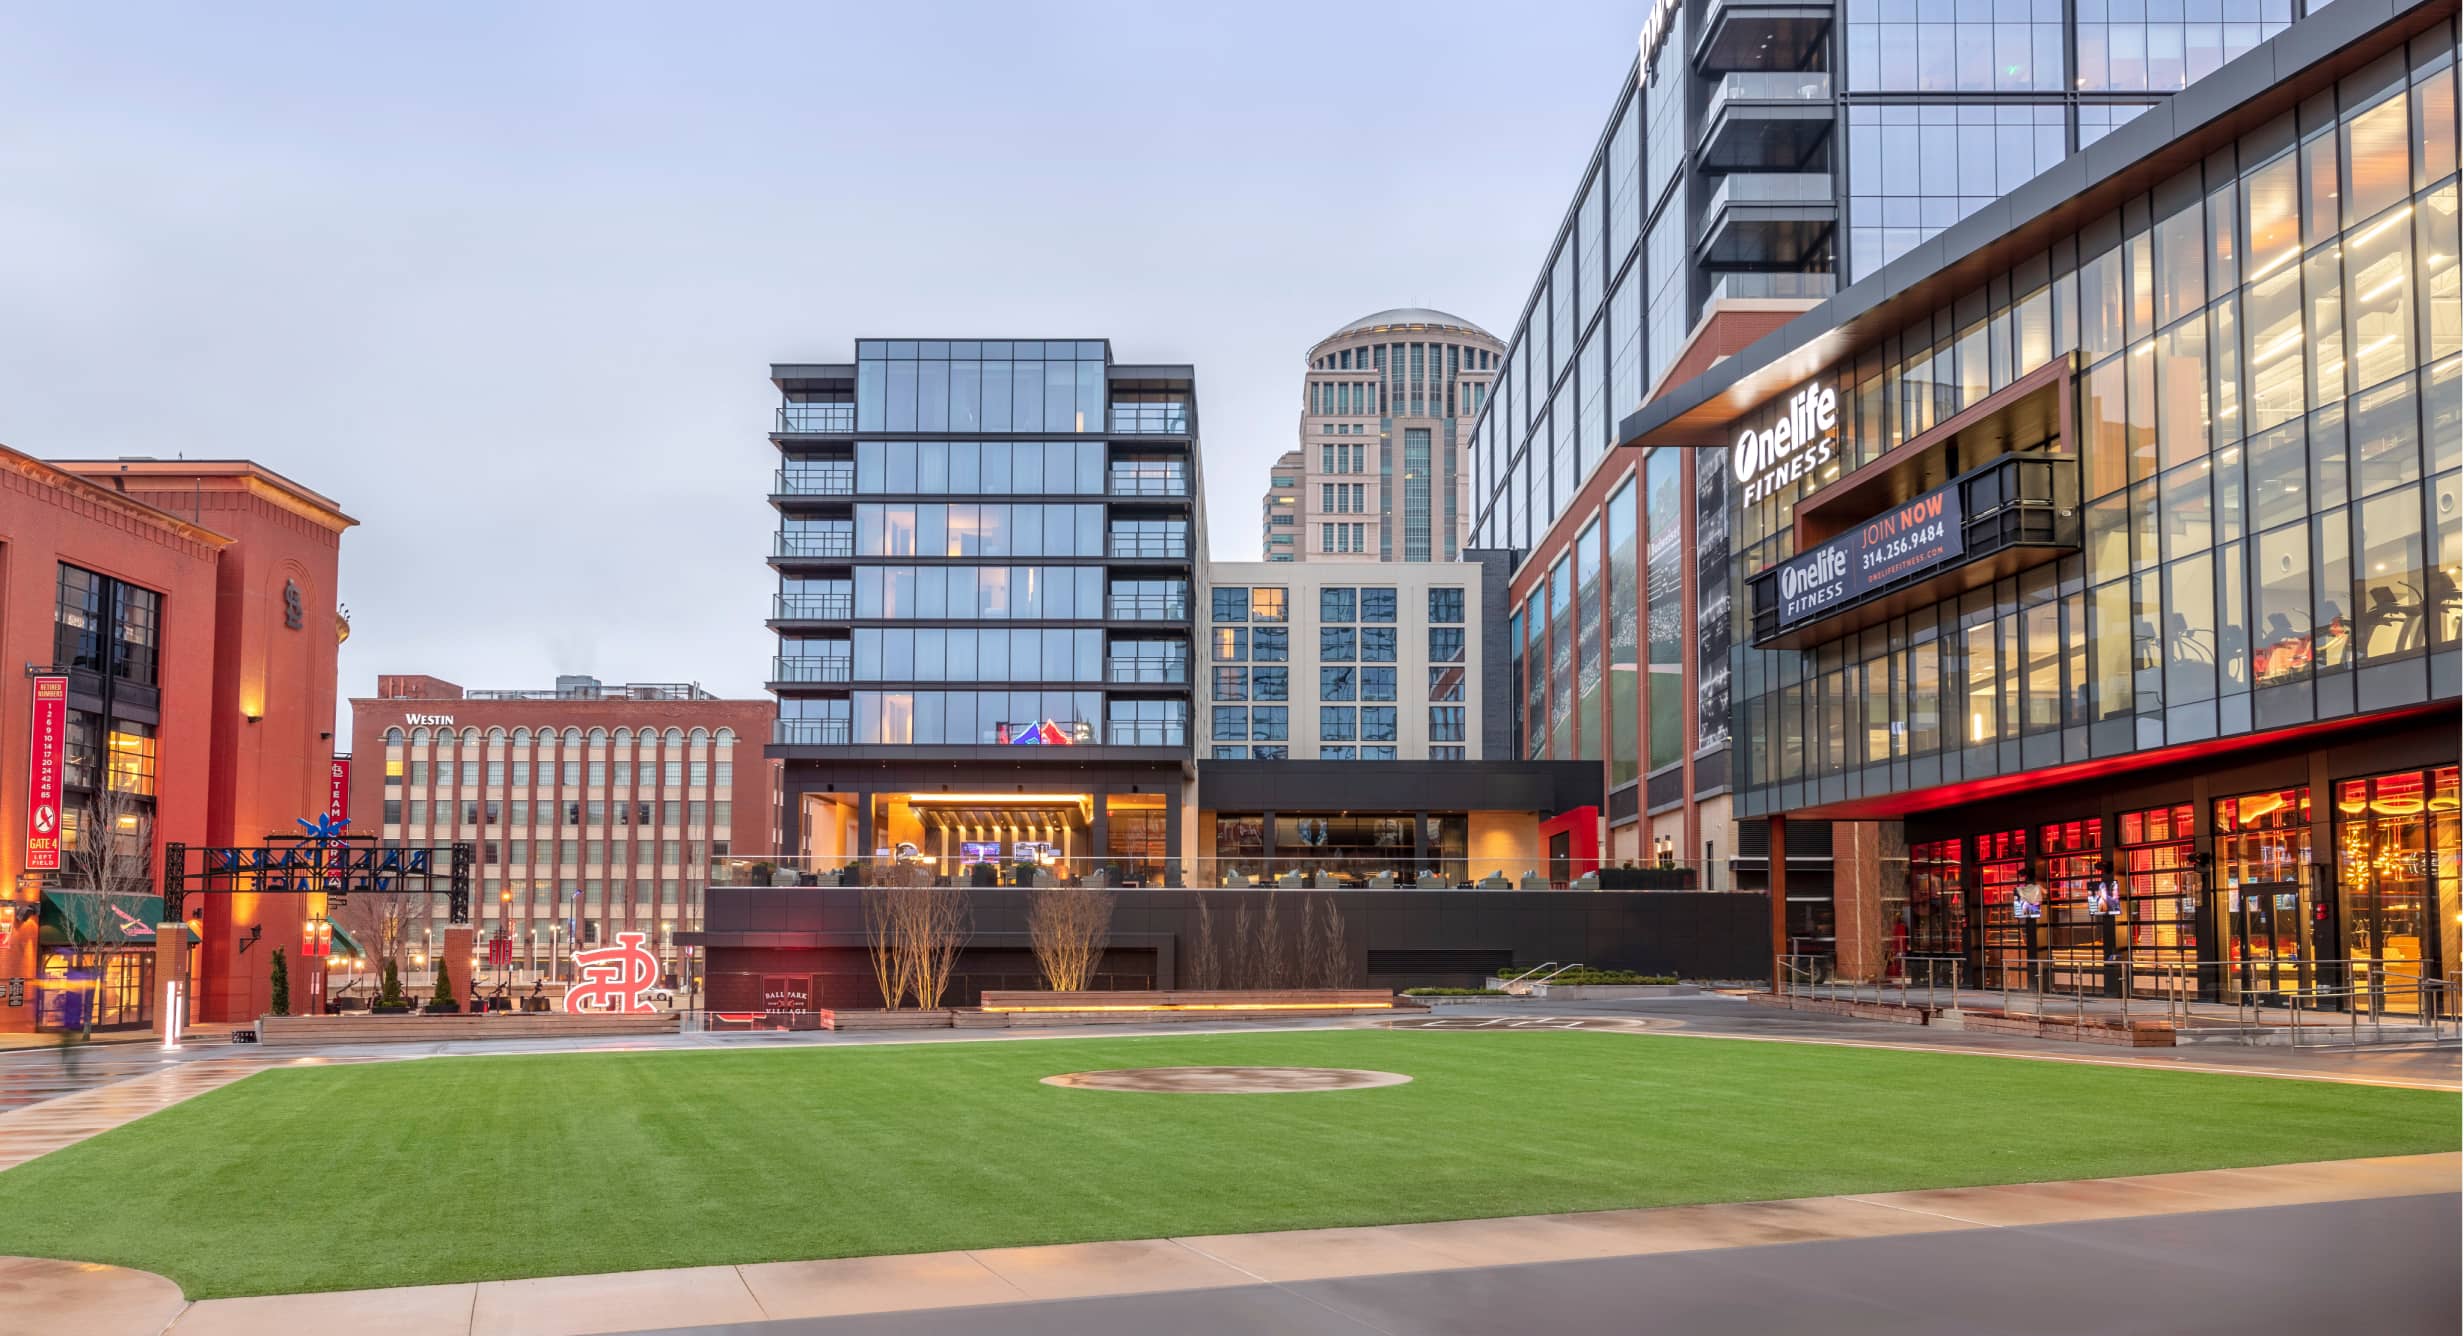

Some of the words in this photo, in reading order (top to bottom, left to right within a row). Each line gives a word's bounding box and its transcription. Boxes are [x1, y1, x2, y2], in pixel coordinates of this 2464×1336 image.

[1639, 0, 1677, 88] pw
[1734, 381, 1836, 483] Onelife
[1743, 437, 1832, 508] FITNESS
[1861, 515, 1896, 549] JOIN
[1901, 493, 1944, 530] NOW
[1863, 521, 1944, 570] 314.256.9484
[1782, 546, 1847, 600] Onelife
[1868, 545, 1944, 583] ONELIFEFITNESS.COM
[1787, 581, 1843, 616] FITNESS
[331, 781, 340, 817] TEAM
[30, 838, 51, 849] GATE
[51, 838, 58, 849] 4
